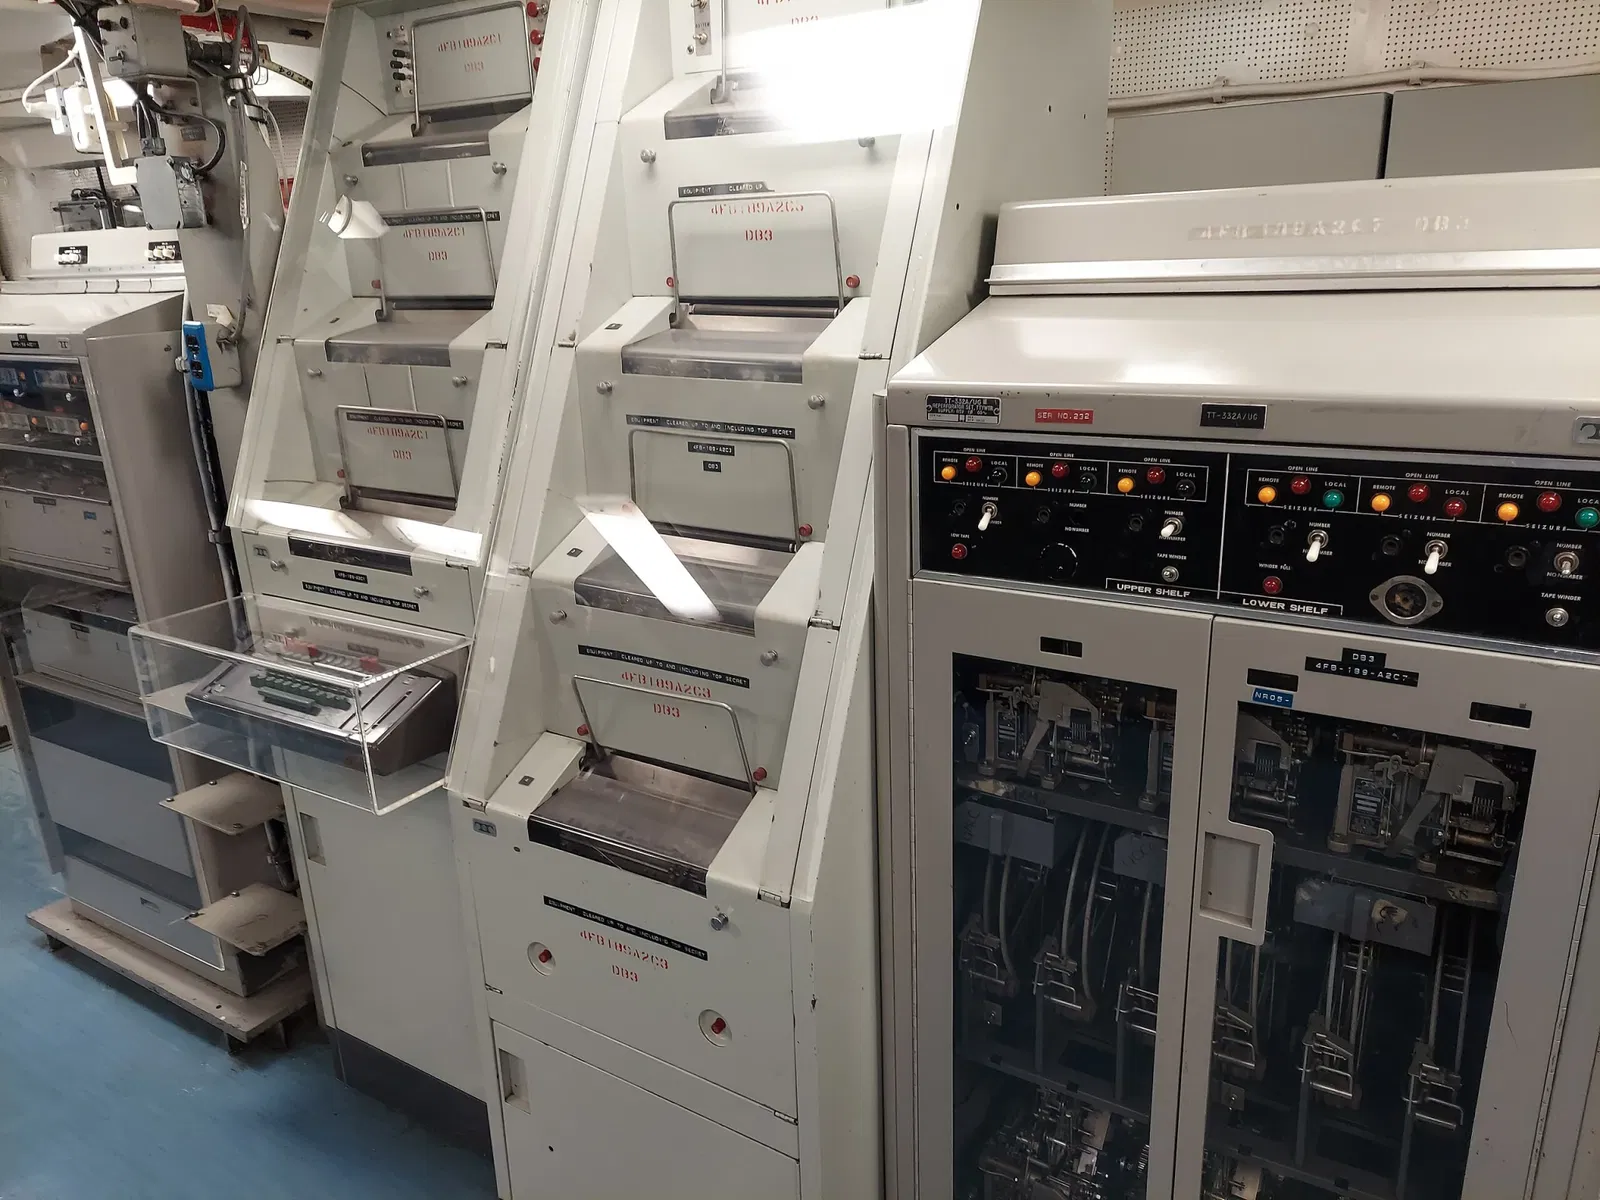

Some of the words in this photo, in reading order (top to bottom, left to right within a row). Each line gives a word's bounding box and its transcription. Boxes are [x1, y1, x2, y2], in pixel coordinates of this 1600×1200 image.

[728, 184, 753, 192] CLEARED
[745, 229, 773, 241] DB3
[1057, 412, 1090, 420] NO.232
[1207, 412, 1258, 420] TT-332A/UG
[724, 424, 754, 433] INCLUDING
[1498, 492, 1524, 500] REMOTE
[1283, 504, 1317, 512] SEIZURE
[1398, 513, 1437, 522] SEIZURE
[1526, 522, 1567, 532] SEIZURE
[1116, 583, 1152, 594] UPPER
[1155, 588, 1190, 598] SHELF
[1242, 598, 1285, 610] LOWER
[1289, 604, 1328, 615] SHELF
[1352, 653, 1375, 663] DB3
[586, 648, 613, 657] EQUIPMENT
[621, 654, 644, 664] CLEARED
[656, 660, 663, 668] TO
[666, 662, 676, 670] AND
[679, 666, 709, 677] INCLUDING
[725, 675, 747, 685] SECRET
[1315, 662, 1408, 682] 4FB-189-A2C7
[626, 925, 636, 933] AND
